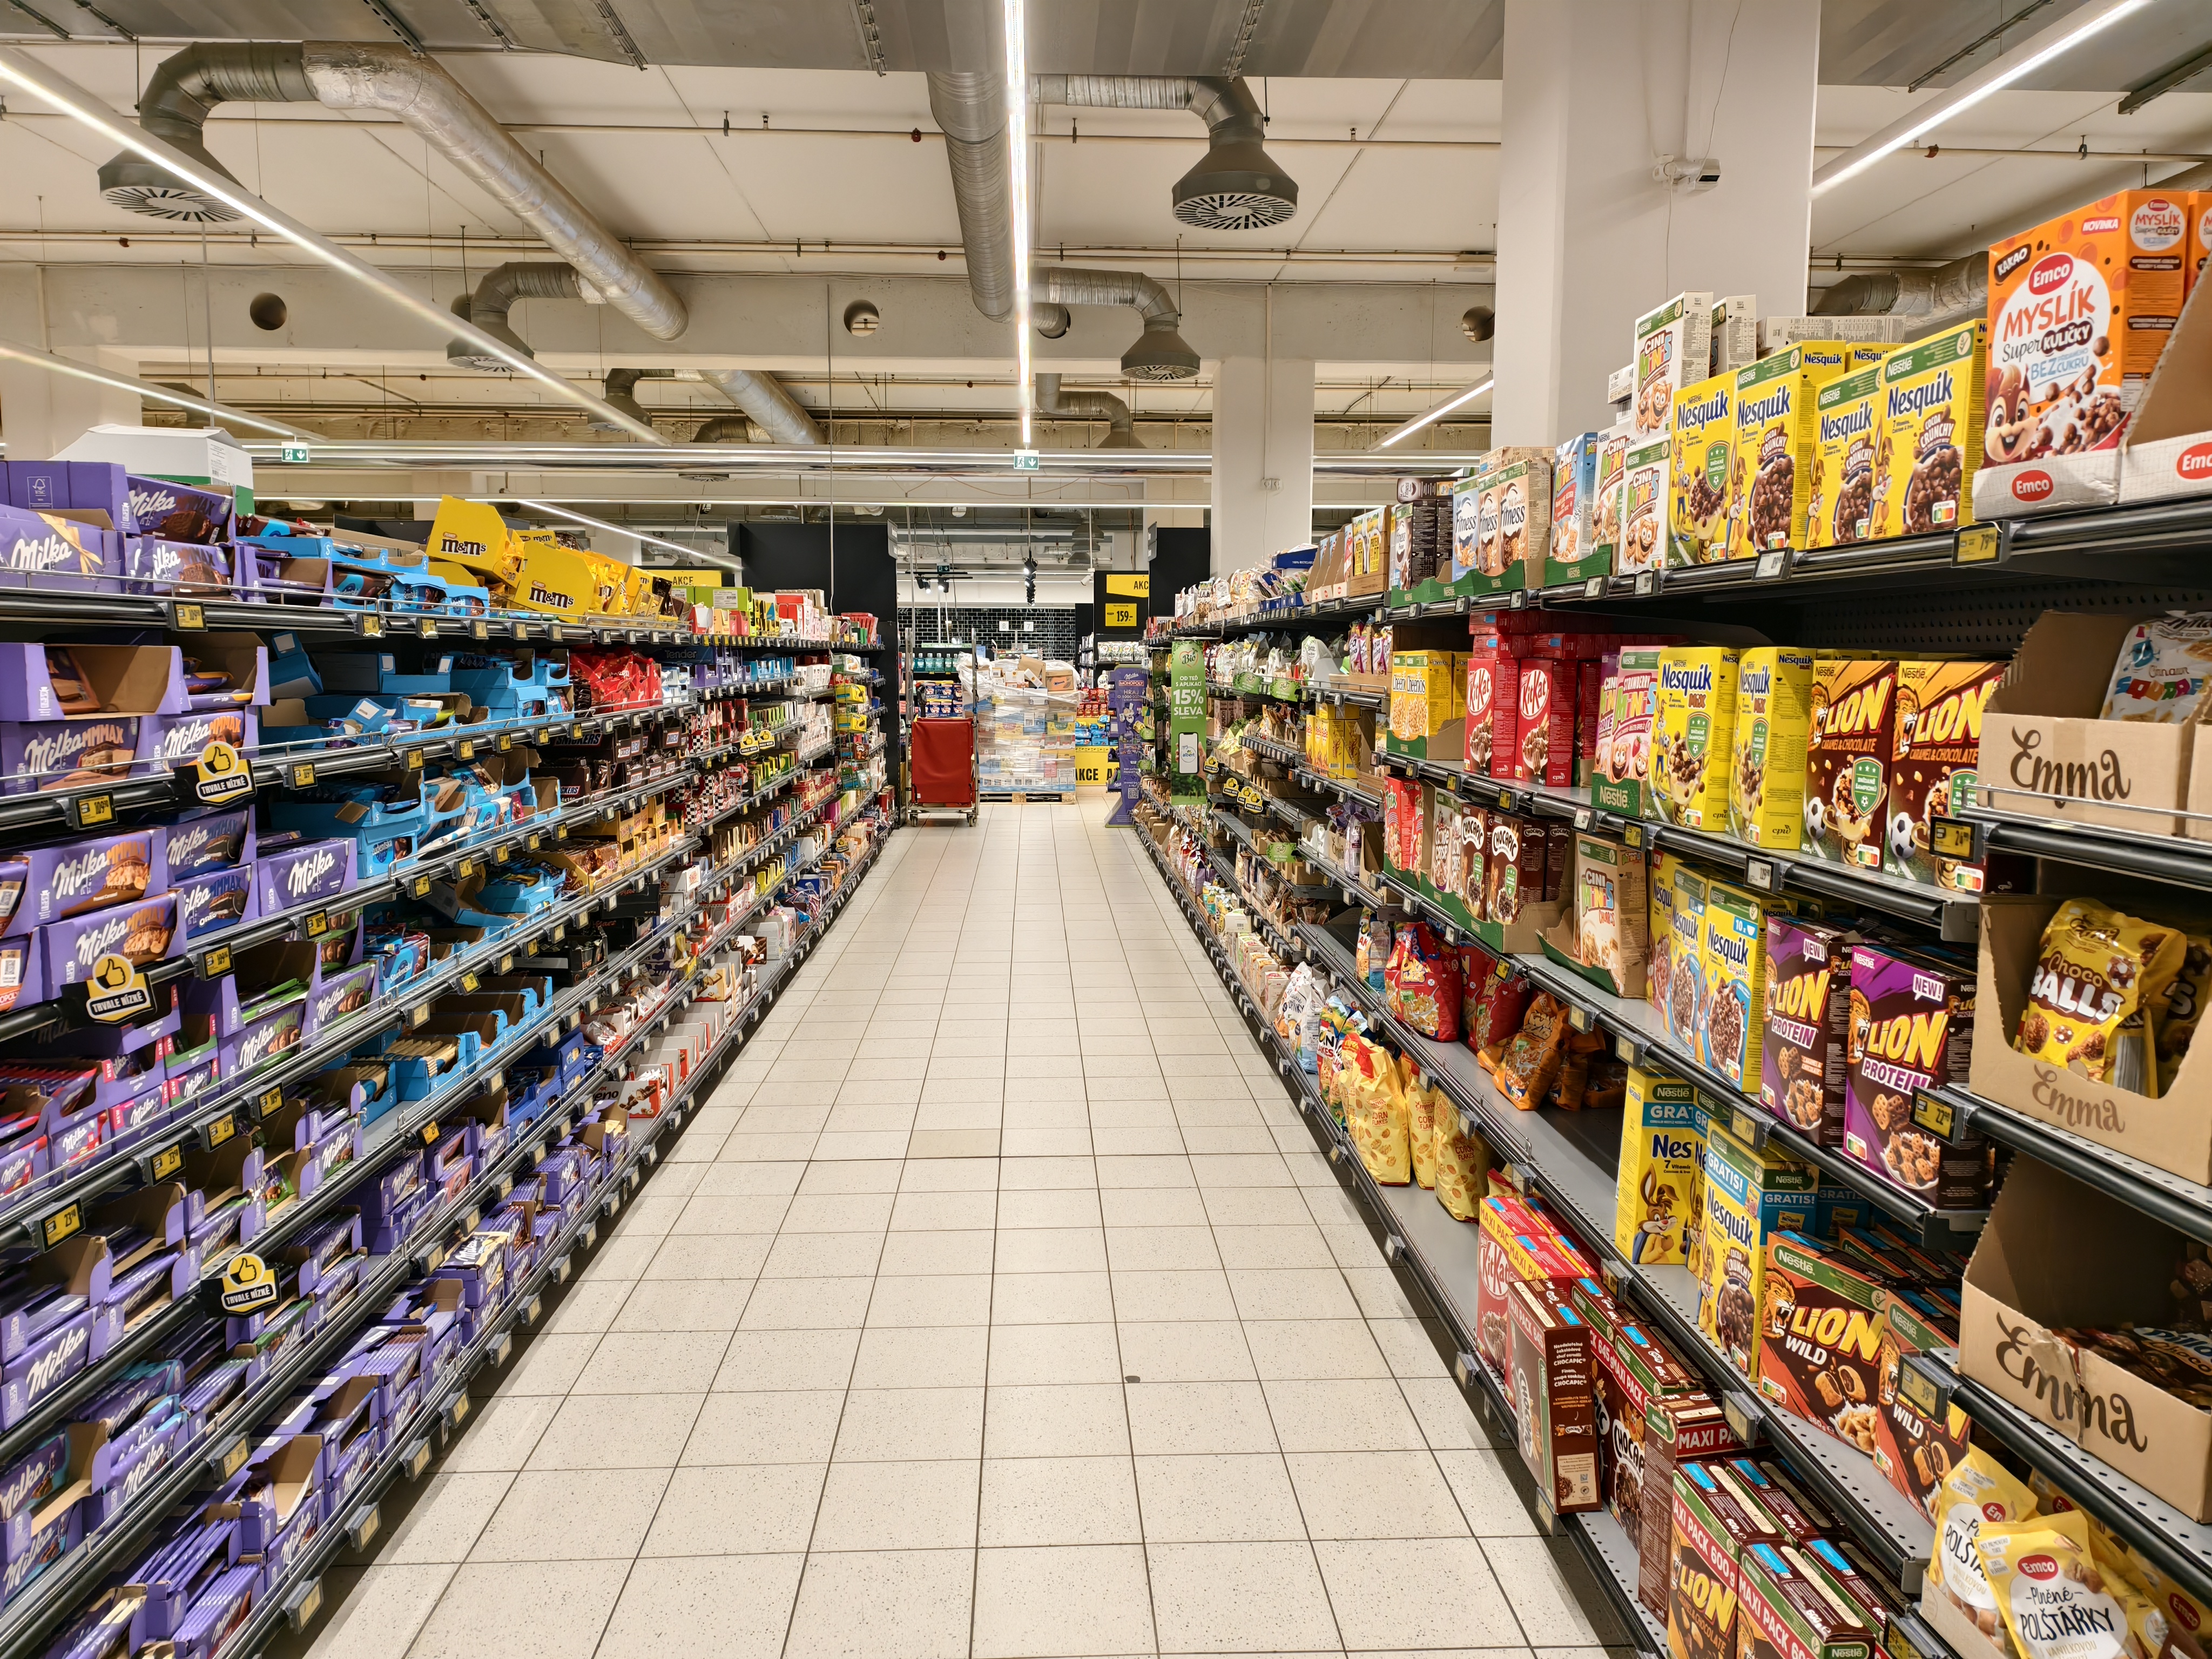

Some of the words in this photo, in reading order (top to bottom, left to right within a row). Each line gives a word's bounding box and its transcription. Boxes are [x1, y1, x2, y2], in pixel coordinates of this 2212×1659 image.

[2082, 218, 2119, 232] NOVINKA
[2135, 211, 2181, 226] MYSLÍK
[1997, 247, 2027, 275] KAKAO
[2033, 265, 2070, 288] Emco
[2004, 280, 2095, 342] MYSLÍK
[1645, 333, 1664, 354] CINI
[2002, 339, 2042, 363] Super
[2043, 323, 2093, 352] KULIČKY
[1804, 354, 1842, 366] Nesquik
[2031, 358, 2058, 380] BEZ
[2058, 356, 2089, 374] CUKRU
[1737, 385, 1790, 428] Nesquik
[1887, 370, 1953, 419] Nesquik
[1677, 389, 1728, 431] Nesquik
[1820, 401, 1872, 442] Nesquik
[1925, 414, 1940, 430] COCOA
[1608, 438, 1626, 455] CINI
[1762, 436, 1787, 456] CRUNCHY
[1764, 429, 1777, 441] COCOA
[1850, 440, 1863, 454] COCOA
[1920, 423, 1954, 448] CRUNCHY
[1846, 449, 1873, 470] CRUNCHY
[2182, 454, 2212, 471] Emc
[1633, 470, 1651, 487] CINI
[2016, 480, 2049, 494] Emco
[129, 490, 176, 517] Milka
[1500, 498, 1525, 528] Fitness
[11, 535, 72, 569] Milka
[673, 576, 694, 585] AKCE
[1134, 581, 1149, 590] AKC
[665, 650, 697, 659] Tender
[1182, 654, 1196, 665] Bio
[1778, 655, 1812, 665] Nesquik
[1407, 676, 1426, 693] Cheerios
[1468, 668, 1492, 711] KitKat
[1623, 676, 1651, 691] STRAWBERRY
[1661, 663, 1712, 696] Nesquik
[1739, 665, 1770, 697] Nesquik
[1173, 689, 1204, 705] 15%
[1522, 670, 1548, 715] KitKat
[1174, 707, 1203, 715] SLEVA
[82, 724, 124, 747] MMMAX
[208, 716, 241, 734] MMMAX
[165, 719, 209, 756] Milka
[555, 733, 601, 746] SNICKERS
[24, 729, 82, 773] Milka
[1076, 768, 1098, 780] AKCE
[2010, 726, 2131, 809] Emma
[201, 783, 225, 795] TRVALE
[226, 776, 246, 790] NÍZKÉ
[561, 786, 579, 794] CKERS
[1386, 786, 1397, 810] Trix
[1462, 818, 1484, 847] CHOCAPIC
[1493, 828, 1518, 860] CHOCAPIC
[106, 841, 146, 864] MMMAX
[166, 825, 210, 866] Milka
[194, 854, 211, 867] OREO
[288, 849, 334, 896] Milka
[53, 849, 107, 899] Milka
[1586, 871, 1605, 885] CINI
[199, 912, 217, 926] OREO
[1672, 904, 1698, 942] Nesquik
[76, 918, 127, 965] Milka
[1708, 922, 1749, 967] Nesquik
[1804, 940, 1824, 960] NEW!
[2048, 950, 2103, 988] Choco
[1916, 977, 1944, 999] NEW!
[2029, 965, 2124, 1022] BALLS
[92, 999, 120, 1013] TRVALE
[122, 990, 143, 1006] NÍZKÉ
[316, 987, 345, 1022] Milka
[1772, 1020, 1817, 1048] PROTEIN
[239, 1024, 275, 1069] Milka
[1863, 1060, 1931, 1094] PROTEIN
[1415, 1101, 1435, 1110] Emma
[2032, 1064, 2125, 1133] Emma
[130, 1098, 154, 1124] Milka
[63, 1125, 86, 1152] Milka
[322, 1130, 349, 1169] Milka
[1455, 1144, 1474, 1154] CORN
[1458, 1152, 1474, 1161] FLAKES
[1708, 1152, 1743, 1193] GRATIS!
[1765, 1193, 1815, 1204] GRATIS!
[1480, 1207, 1495, 1232] MAXI
[1496, 1225, 1510, 1245] PAC
[1707, 1185, 1752, 1251] Nesquik
[1730, 1249, 1742, 1260] COCOA
[1481, 1242, 1510, 1294] KitKat
[1728, 1259, 1752, 1282] CRUNCHY
[226, 1292, 249, 1305] TRVALE
[250, 1285, 271, 1300] NÍZKÉ
[1520, 1310, 1532, 1336] PACK
[1533, 1325, 1543, 1349] 645
[26, 1326, 86, 1399] Milka
[1785, 1336, 1827, 1365] WILD
[1614, 1359, 1626, 1386] MAXI
[1627, 1374, 1643, 1406] PACK
[1995, 1311, 2148, 1453] Emma
[1894, 1404, 1924, 1439] WILD
[1678, 1431, 1715, 1449] MAXI
[2023, 1561, 2055, 1573] Emco
[1739, 1580, 1761, 1616] MAXI
[1763, 1608, 1789, 1647] PACK
[2020, 1603, 2114, 1642] POLŠTÁŘKY
[2171, 1596, 2200, 1629] Emco
[2046, 1640, 2097, 1657] VANILKOVOU
